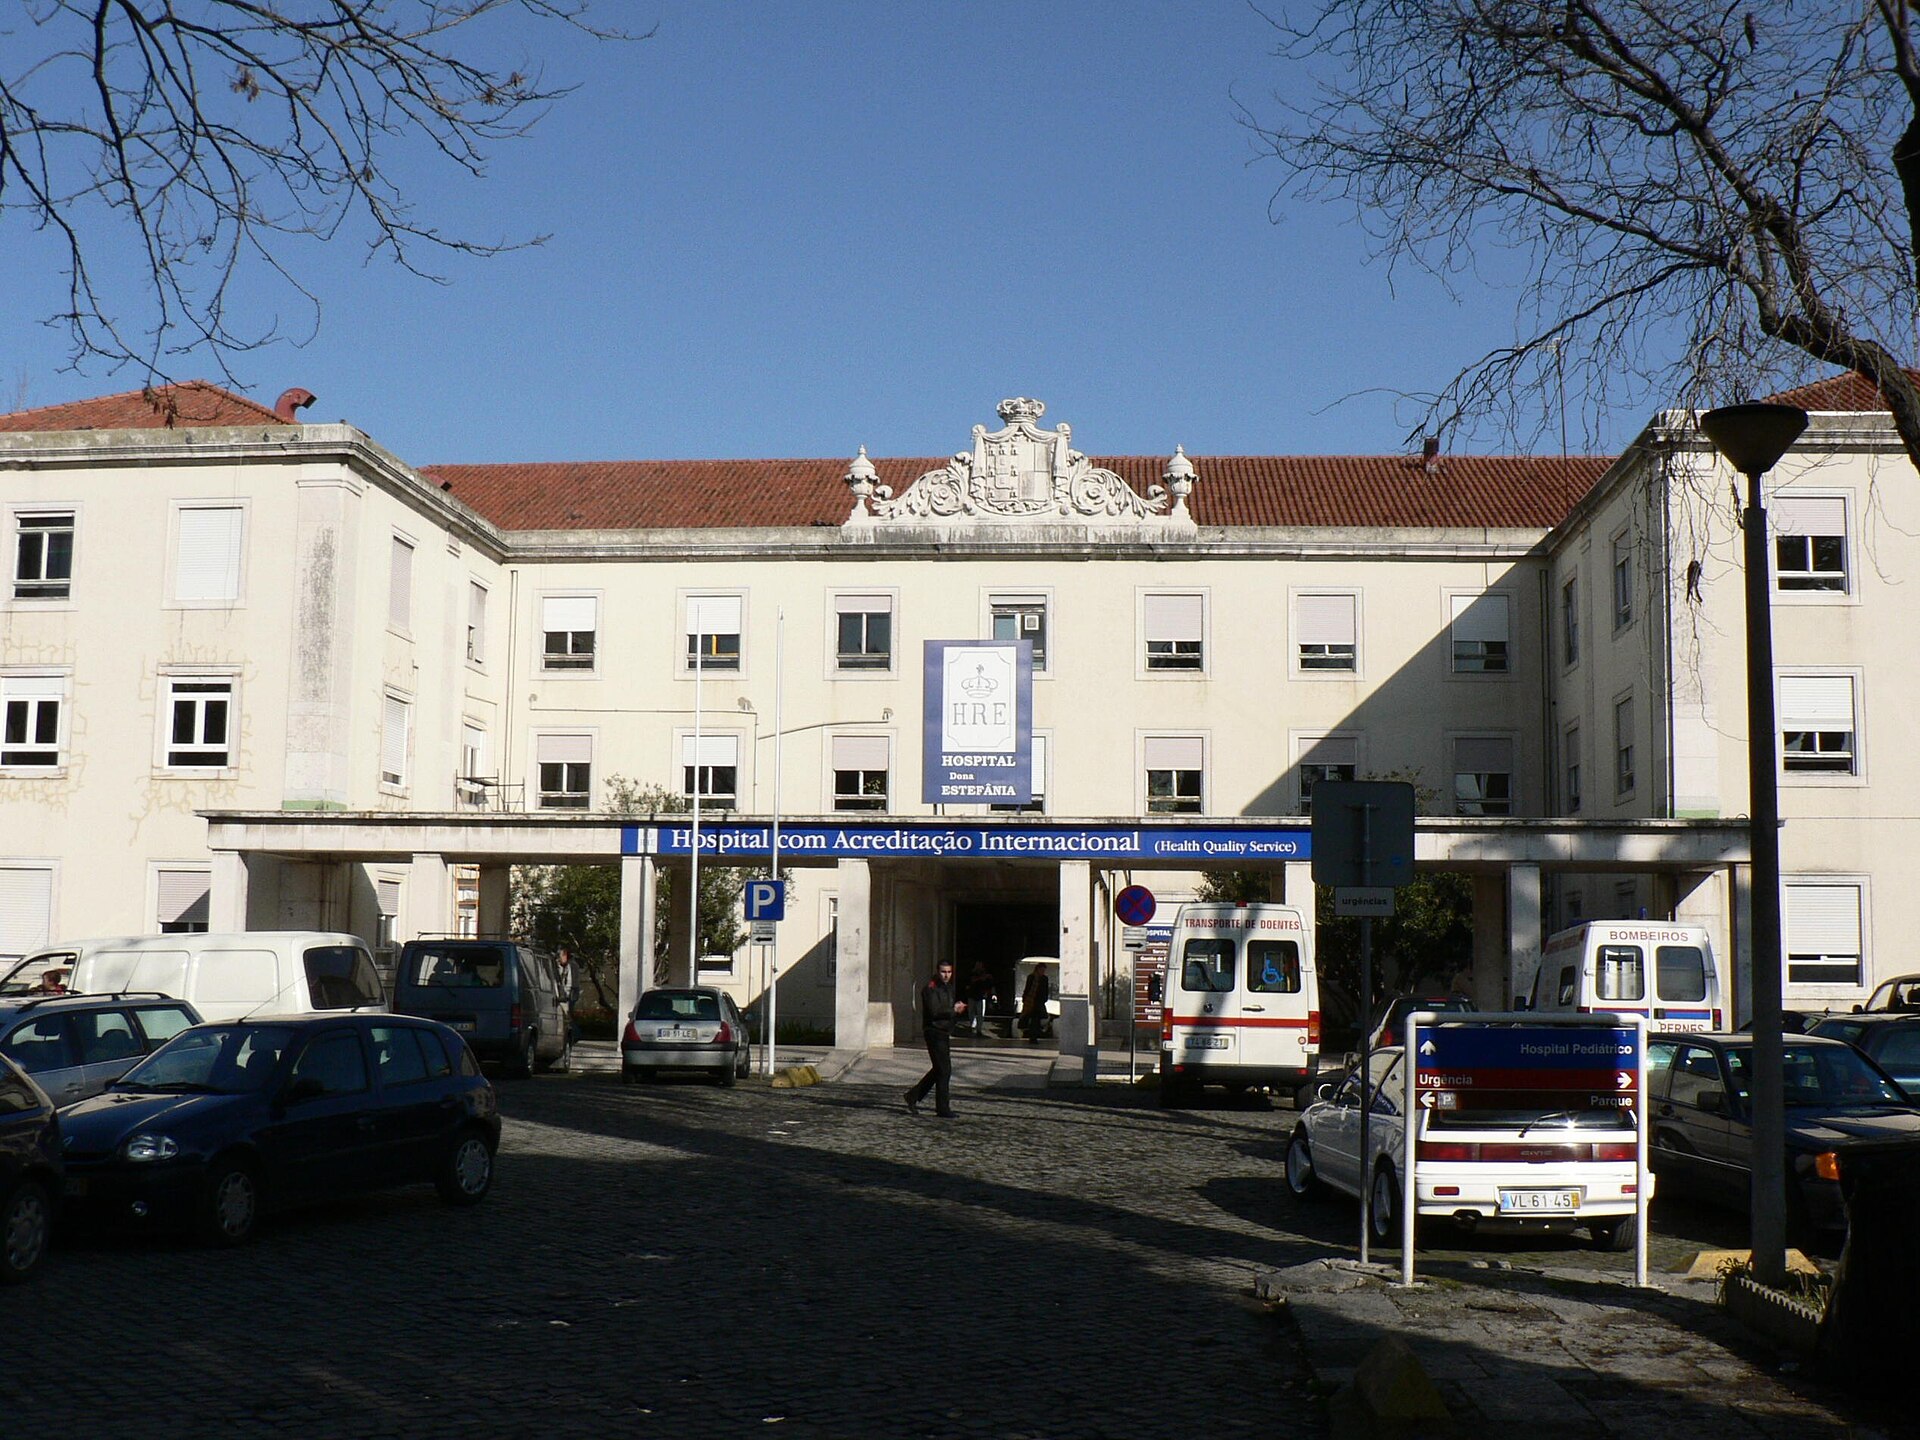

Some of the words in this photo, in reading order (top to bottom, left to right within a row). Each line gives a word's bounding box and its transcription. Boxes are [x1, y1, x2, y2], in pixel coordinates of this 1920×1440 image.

[941, 755, 1016, 767] HOSPITAL
[949, 772, 975, 780] Dona
[941, 783, 1017, 796] ESTEFÂNIA
[671, 829, 769, 853] Hospital
[776, 834, 826, 849] com
[832, 829, 972, 855] Acreditação
[979, 831, 1140, 851] Internacional
[1154, 840, 1200, 854] (Health
[1203, 840, 1247, 855] Quality
[1249, 840, 1297, 855] Service)
[753, 884, 776, 918] P
[1185, 918, 1241, 929] TRANSPORTE
[1245, 918, 1256, 929] DE
[1260, 919, 1299, 930] DOENTES
[1609, 930, 1689, 942] BOMBEIROS
[1520, 1043, 1569, 1057] Hospital
[1572, 1043, 1633, 1055] Pediátrico
[1419, 1073, 1473, 1088] Urgência
[1590, 1095, 1633, 1108] Parque
